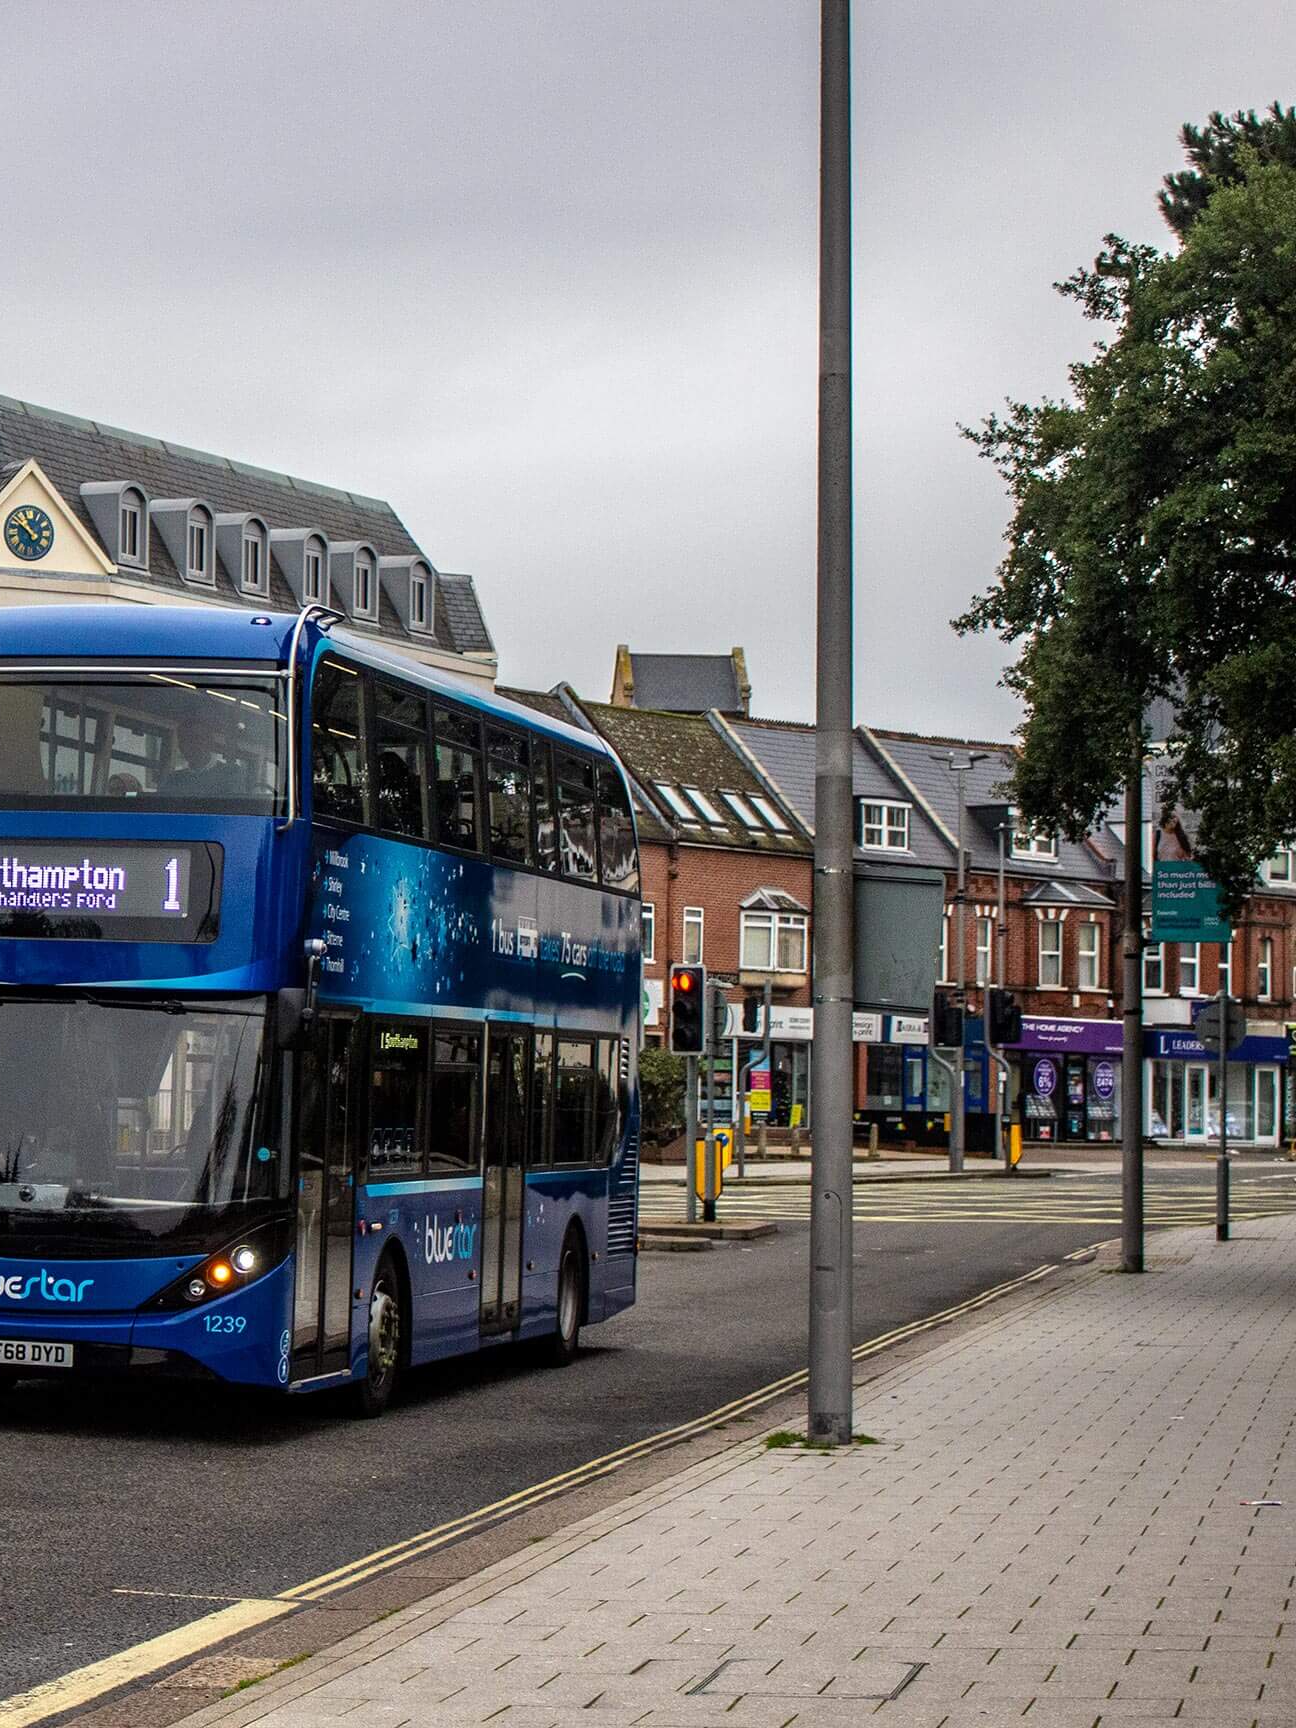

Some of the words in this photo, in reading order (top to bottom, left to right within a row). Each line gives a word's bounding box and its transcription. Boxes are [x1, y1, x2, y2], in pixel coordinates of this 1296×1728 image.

[1157, 870, 1169, 879] So
[1170, 871, 1195, 879] much
[164, 858, 180, 910] 1
[1157, 880, 1178, 889] than
[1179, 881, 1196, 890] just
[1197, 881, 1217, 889] bills
[76, 893, 116, 909] Ford
[1157, 890, 1196, 898] included
[491, 918, 497, 953] 1
[498, 917, 514, 956] bus
[561, 931, 572, 965] 75
[572, 943, 587, 968] cars
[1022, 1023, 1035, 1032] THE
[1036, 1023, 1056, 1032] HOME
[1057, 1025, 1084, 1034] AGENCY
[203, 1314, 247, 1335] 1239
[31, 1344, 65, 1363] DYD
